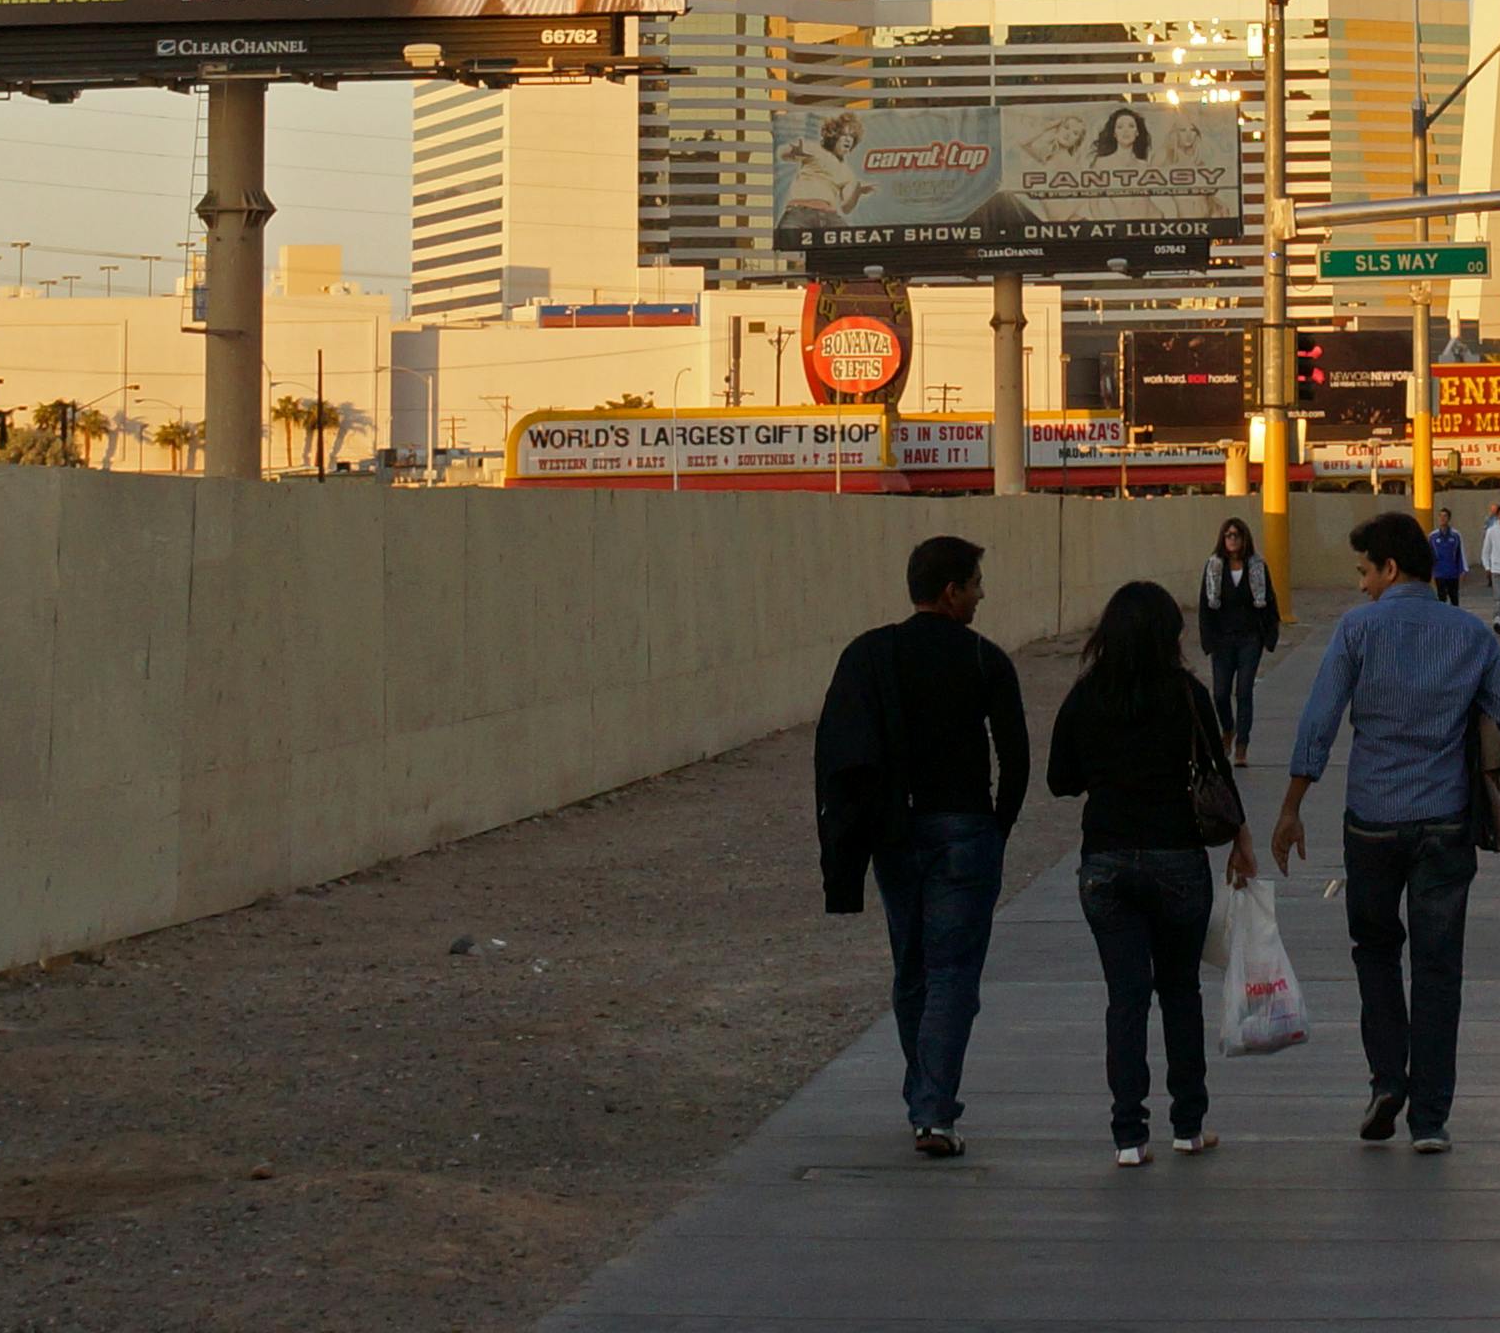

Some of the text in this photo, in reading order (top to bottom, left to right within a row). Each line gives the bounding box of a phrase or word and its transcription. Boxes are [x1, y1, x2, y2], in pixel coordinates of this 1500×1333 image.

[541, 29, 598, 44] 66762
[866, 143, 987, 171] carrot top
[1022, 168, 1226, 189] FANTASY
[801, 232, 813, 245] 2
[824, 229, 894, 244] GREAT
[904, 227, 982, 241] SHOWS
[1024, 225, 1081, 239] ONLY
[1090, 224, 1116, 238] AT
[1126, 222, 1210, 237] LUXOR
[1323, 252, 1331, 263] E
[1355, 253, 1438, 272] SLS WAY
[823, 331, 891, 355] BONANZA
[832, 359, 881, 379] GIFTS
[1032, 422, 1121, 442] BONANZA'S
[1431, 413, 1462, 432] HOP
[528, 423, 879, 449] WORLD'S LARGEST GIFT SHOP
[918, 427, 930, 441] IN
[939, 426, 984, 441] STOCK
[904, 448, 938, 463] HAVE
[1460, 444, 1480, 453] LAS
[538, 457, 587, 471] WESTERN
[592, 457, 621, 470] GIFTS
[636, 456, 666, 469] HATS
[687, 455, 718, 467] BELTS
[738, 453, 795, 466] SOUVENIRS
[1323, 460, 1350, 470] GIFTS
